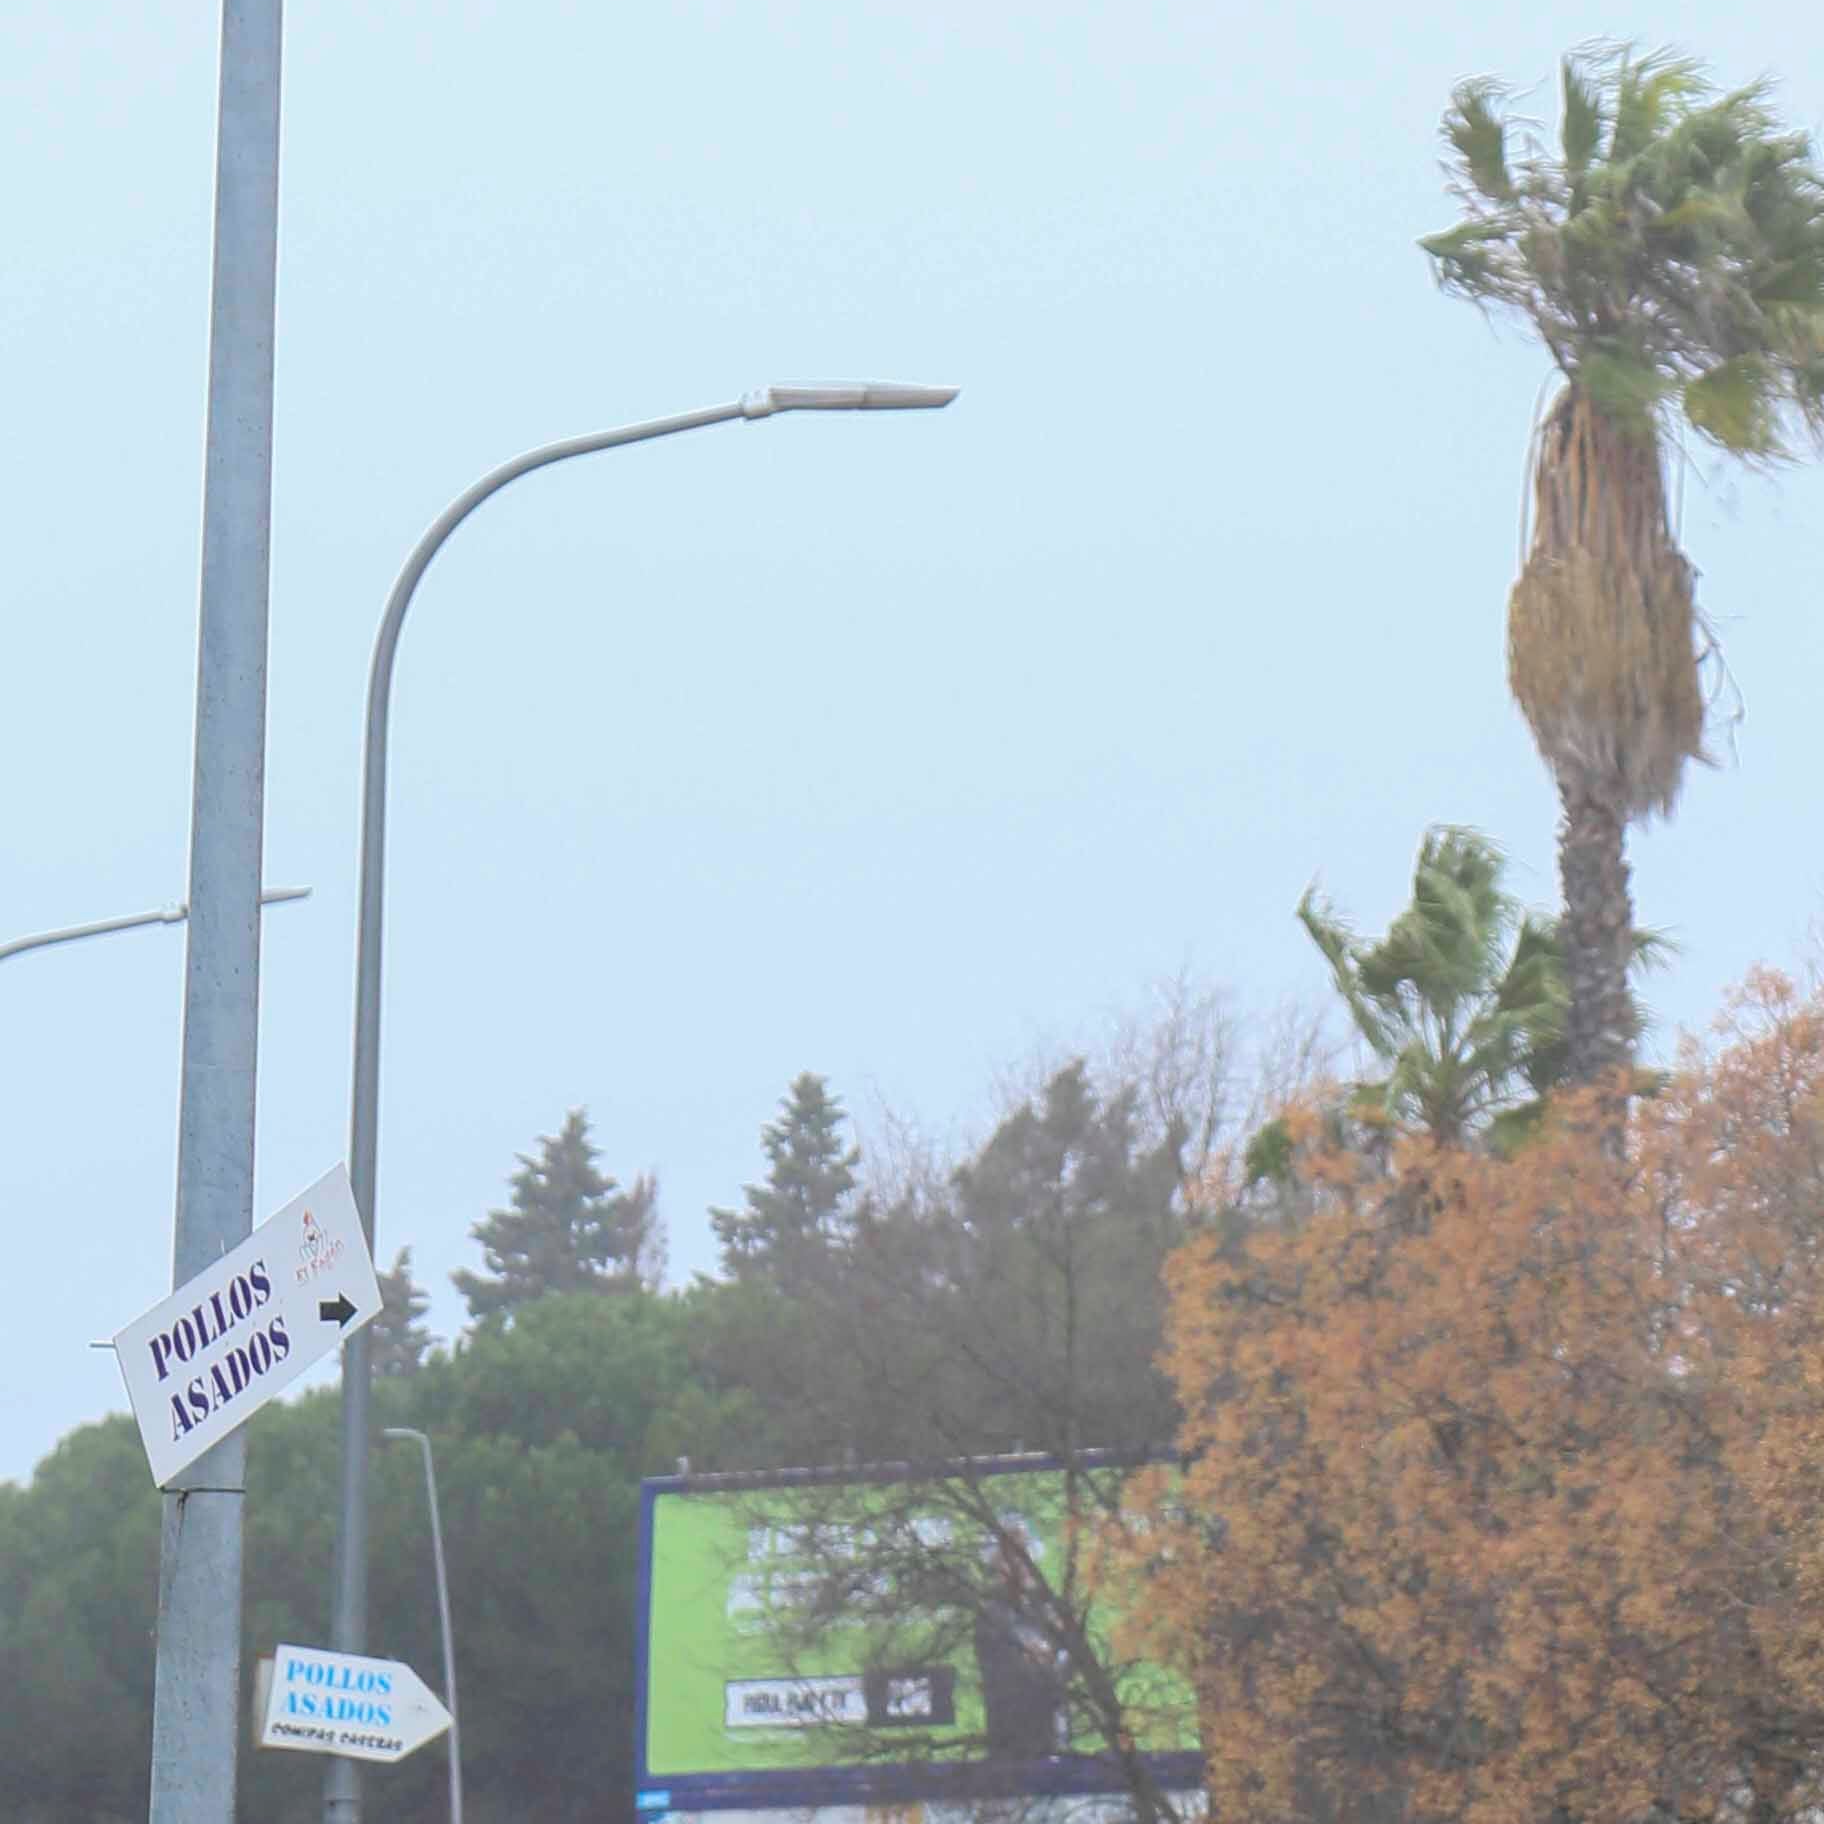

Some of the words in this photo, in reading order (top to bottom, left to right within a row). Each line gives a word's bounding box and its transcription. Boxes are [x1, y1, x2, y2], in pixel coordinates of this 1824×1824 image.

[147, 1259, 272, 1382] POLLOS
[169, 1313, 291, 1442] ASADOS
[282, 1691, 393, 1727] ASADOS
[286, 1659, 393, 1696] POLLOS
